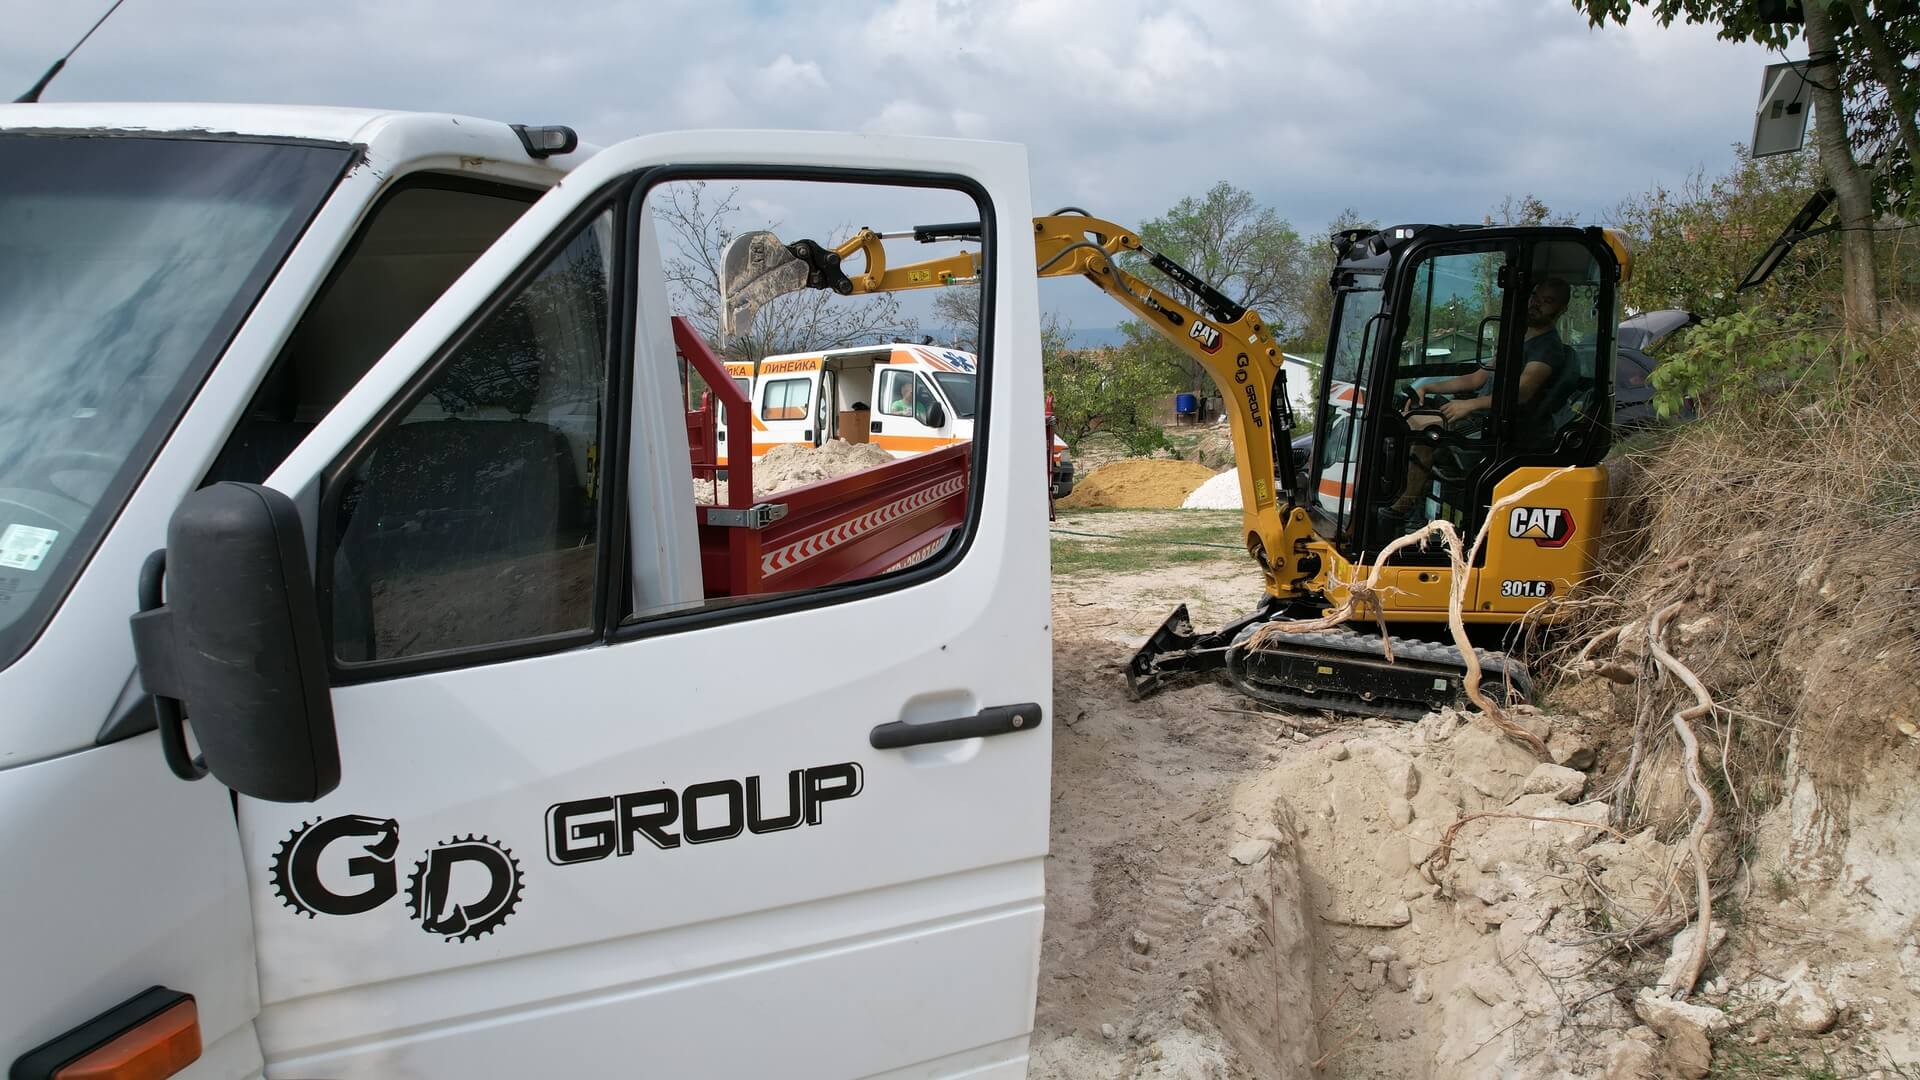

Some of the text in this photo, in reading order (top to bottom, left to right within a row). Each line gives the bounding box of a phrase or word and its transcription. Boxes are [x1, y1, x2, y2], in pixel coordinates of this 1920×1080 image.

[1189, 320, 1220, 347] CAT
[763, 360, 817, 374] ЛИНЕЙКА
[1245, 384, 1263, 428] GROUP
[1509, 507, 1562, 539] CAT
[1501, 580, 1547, 597] 301.6
[544, 761, 865, 866] GROUP
